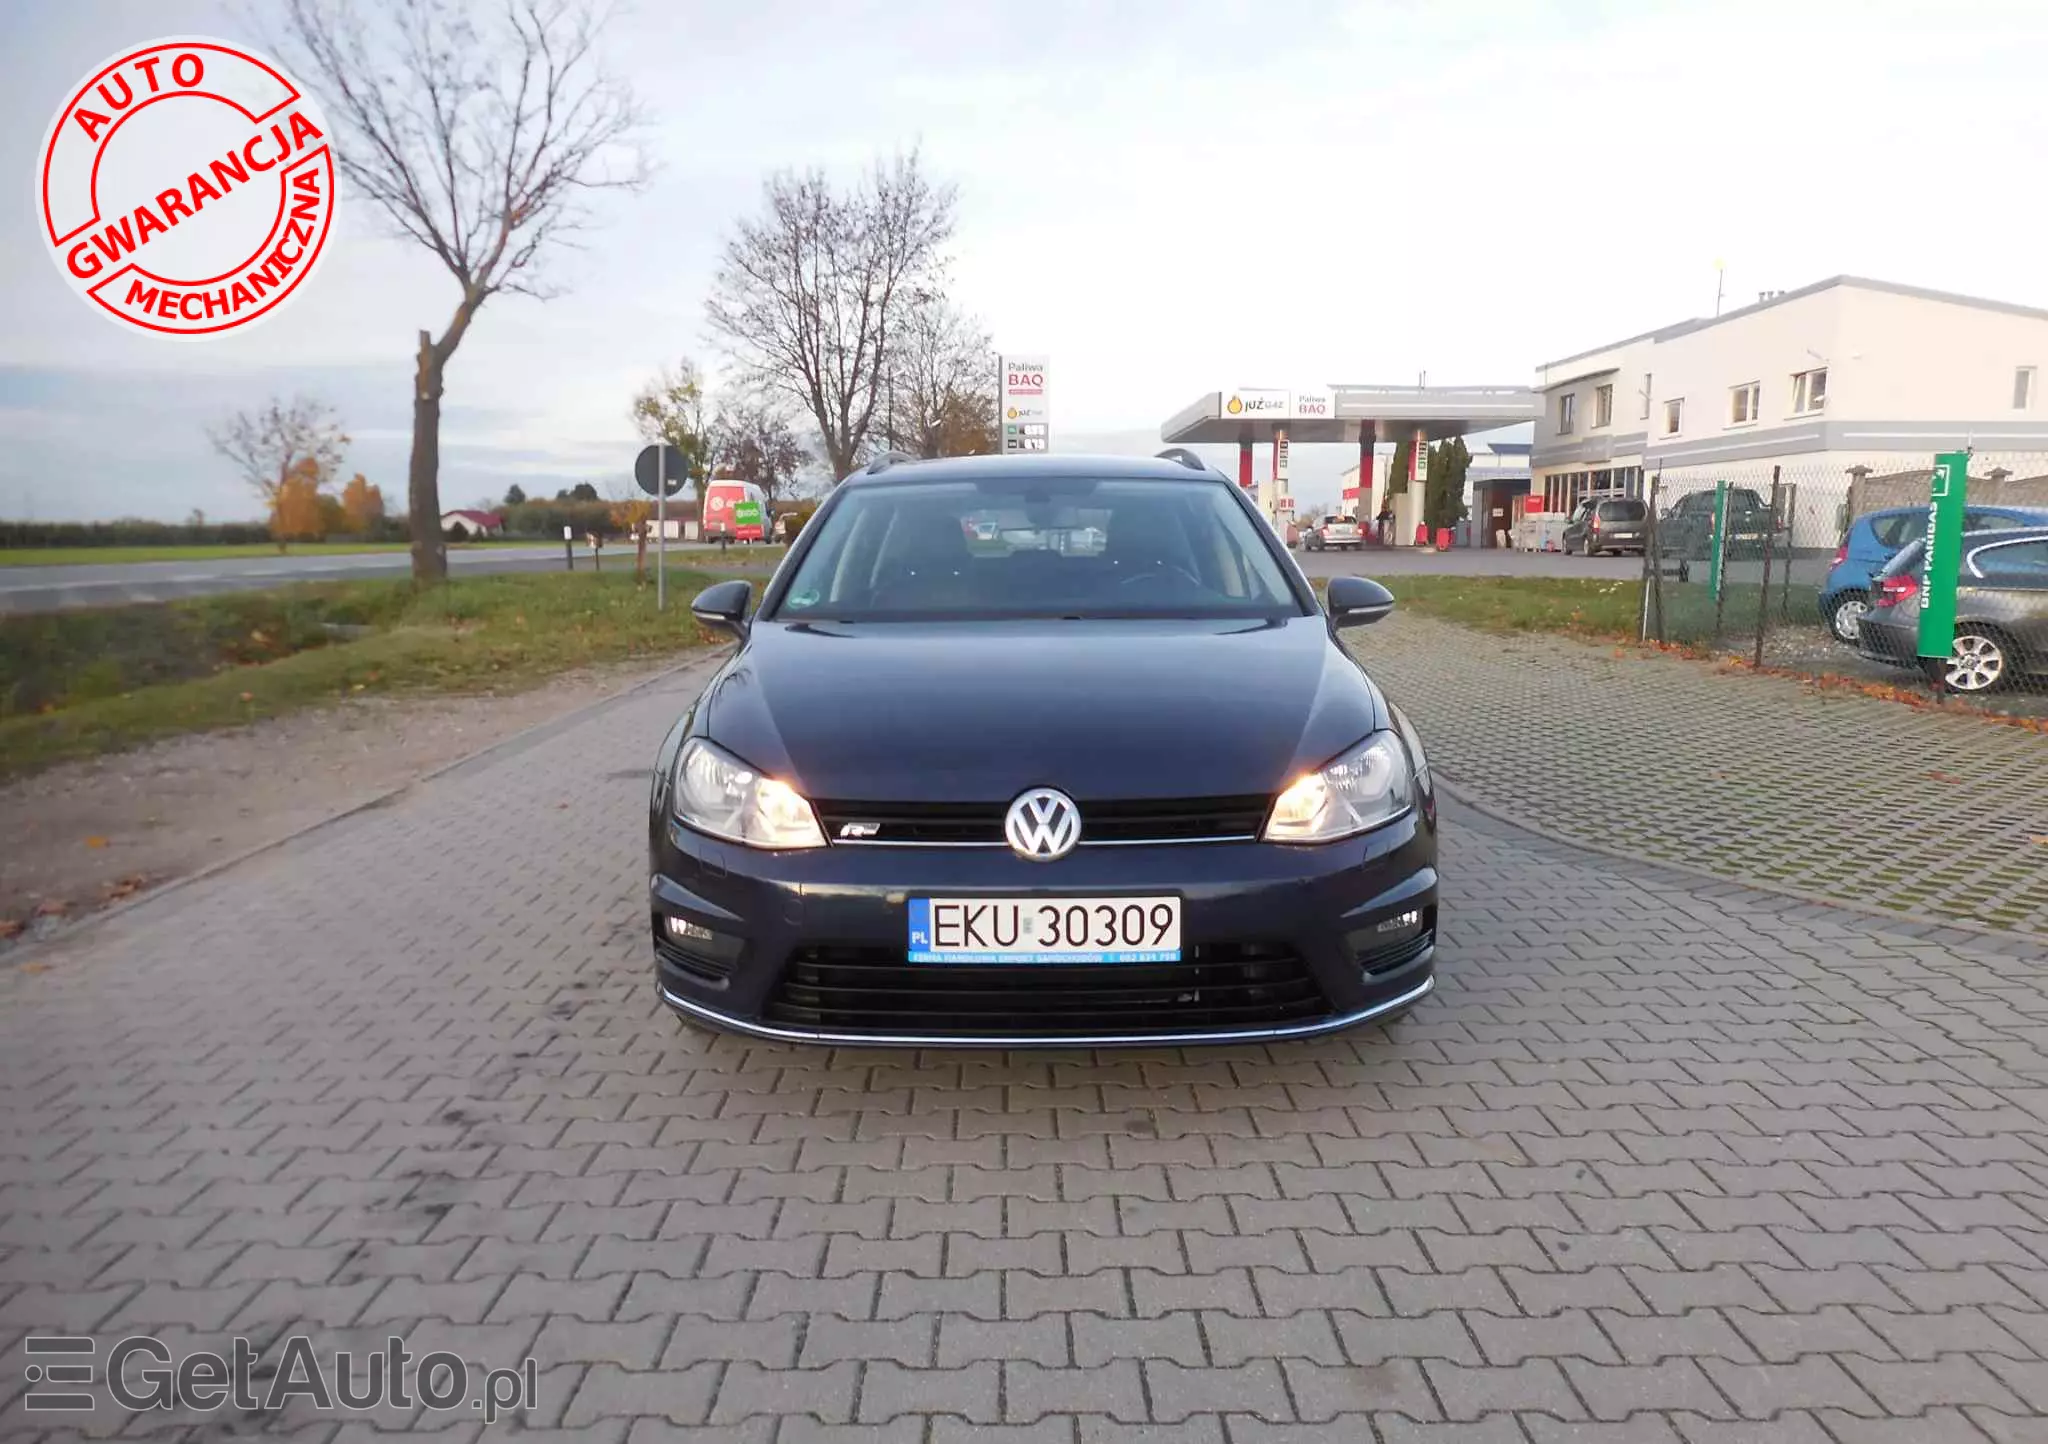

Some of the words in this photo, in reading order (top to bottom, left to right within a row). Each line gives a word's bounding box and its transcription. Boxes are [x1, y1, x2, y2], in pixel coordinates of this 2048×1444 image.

[1008, 362, 1043, 372] Paliwa
[1008, 374, 1043, 387] BAQ
[1299, 394, 1326, 403] Paliwa
[1299, 404, 1326, 414] BAQ
[1924, 501, 1938, 571] PARIBAS
[1920, 574, 1931, 608] BNP
[934, 905, 1019, 947] EKU
[1037, 903, 1173, 947] 30309
[912, 931, 928, 944] PL
